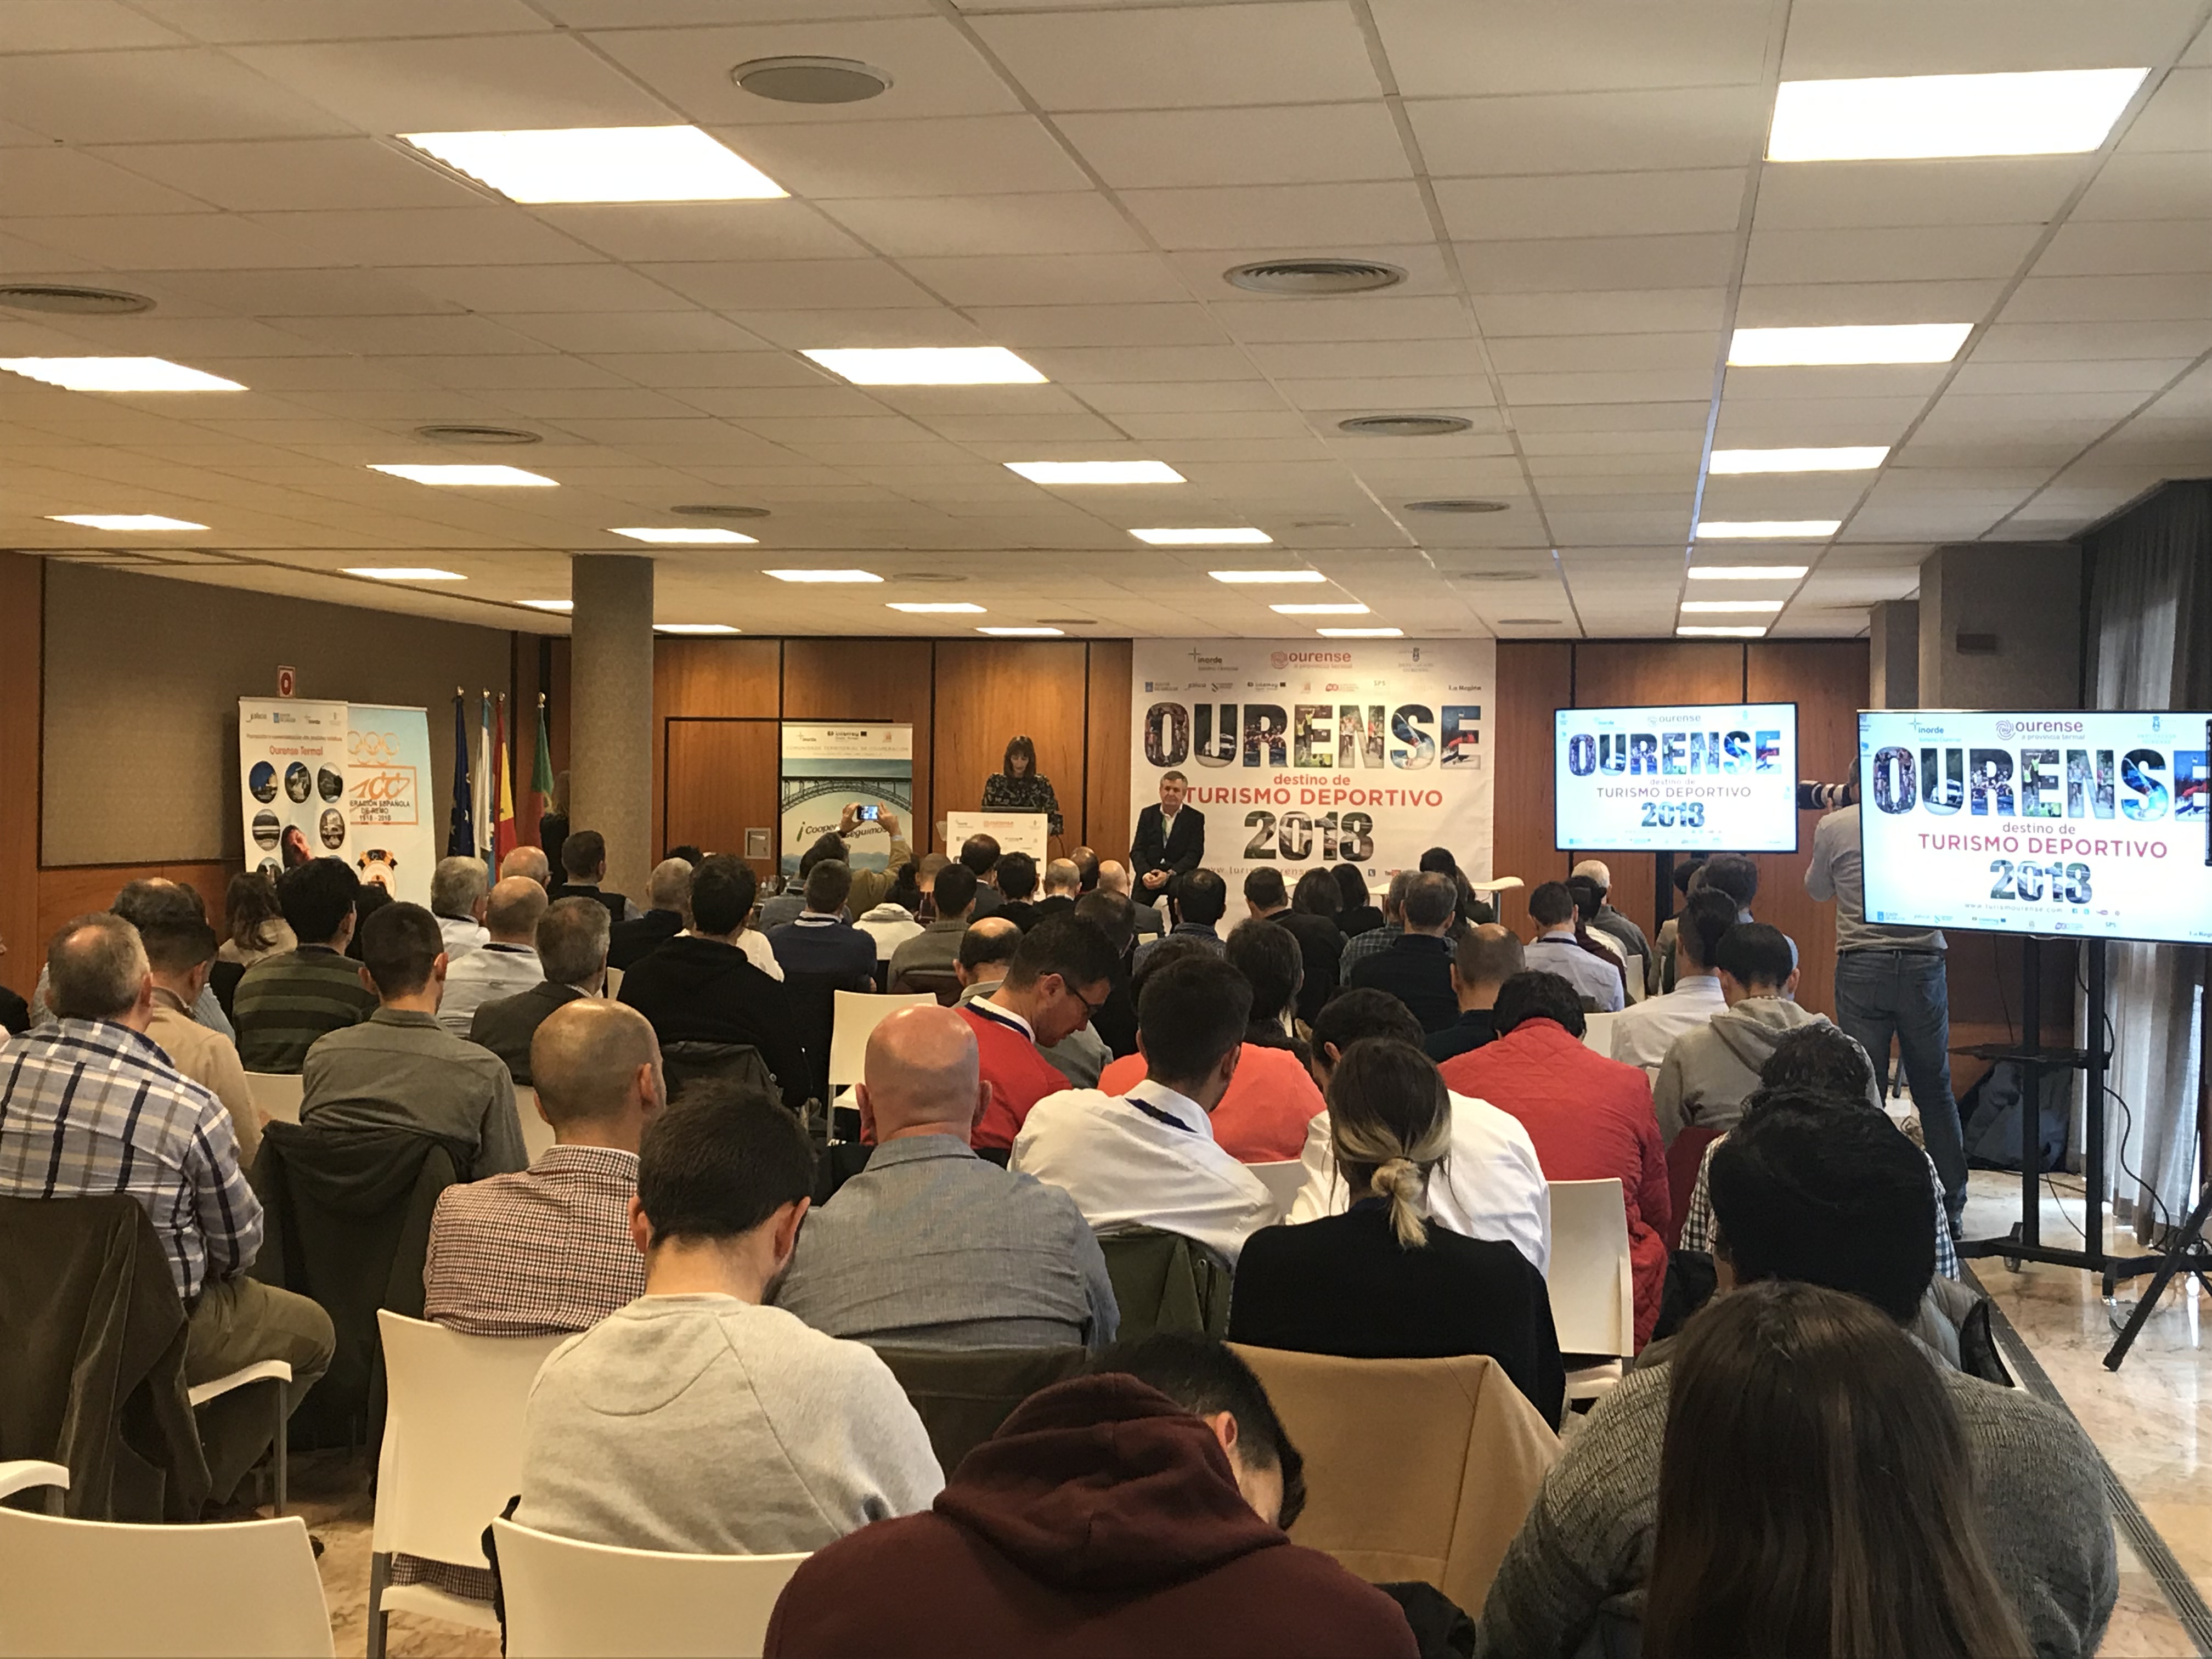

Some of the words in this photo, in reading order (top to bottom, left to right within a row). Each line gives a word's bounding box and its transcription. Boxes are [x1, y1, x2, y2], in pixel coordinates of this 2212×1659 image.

[1289, 651, 1351, 662] ourense
[1144, 702, 1481, 769] OURENSE
[2016, 720, 2083, 732] ourense
[269, 745, 299, 755] Ourense
[301, 746, 323, 755] Termal
[1569, 730, 1782, 776] OURENSE
[1273, 774, 1328, 786] destino
[1333, 774, 1350, 786] de
[1873, 746, 2207, 822] OURENSE
[1186, 786, 1291, 806] TURISMO
[1300, 788, 1443, 807] DEPORTIVO
[1597, 787, 1660, 798] TURISMO
[1666, 786, 1751, 798] DEPORTIVO
[379, 799, 410, 808] ESPAÑOLA
[1641, 802, 1705, 827] 2018
[1243, 811, 1374, 862] 2018
[2002, 822, 2053, 834] destino
[2059, 823, 2076, 834] de
[1918, 833, 2019, 853] TURISMO
[2029, 838, 2167, 859] DEPORTIVO
[1990, 860, 2092, 904] 2018
